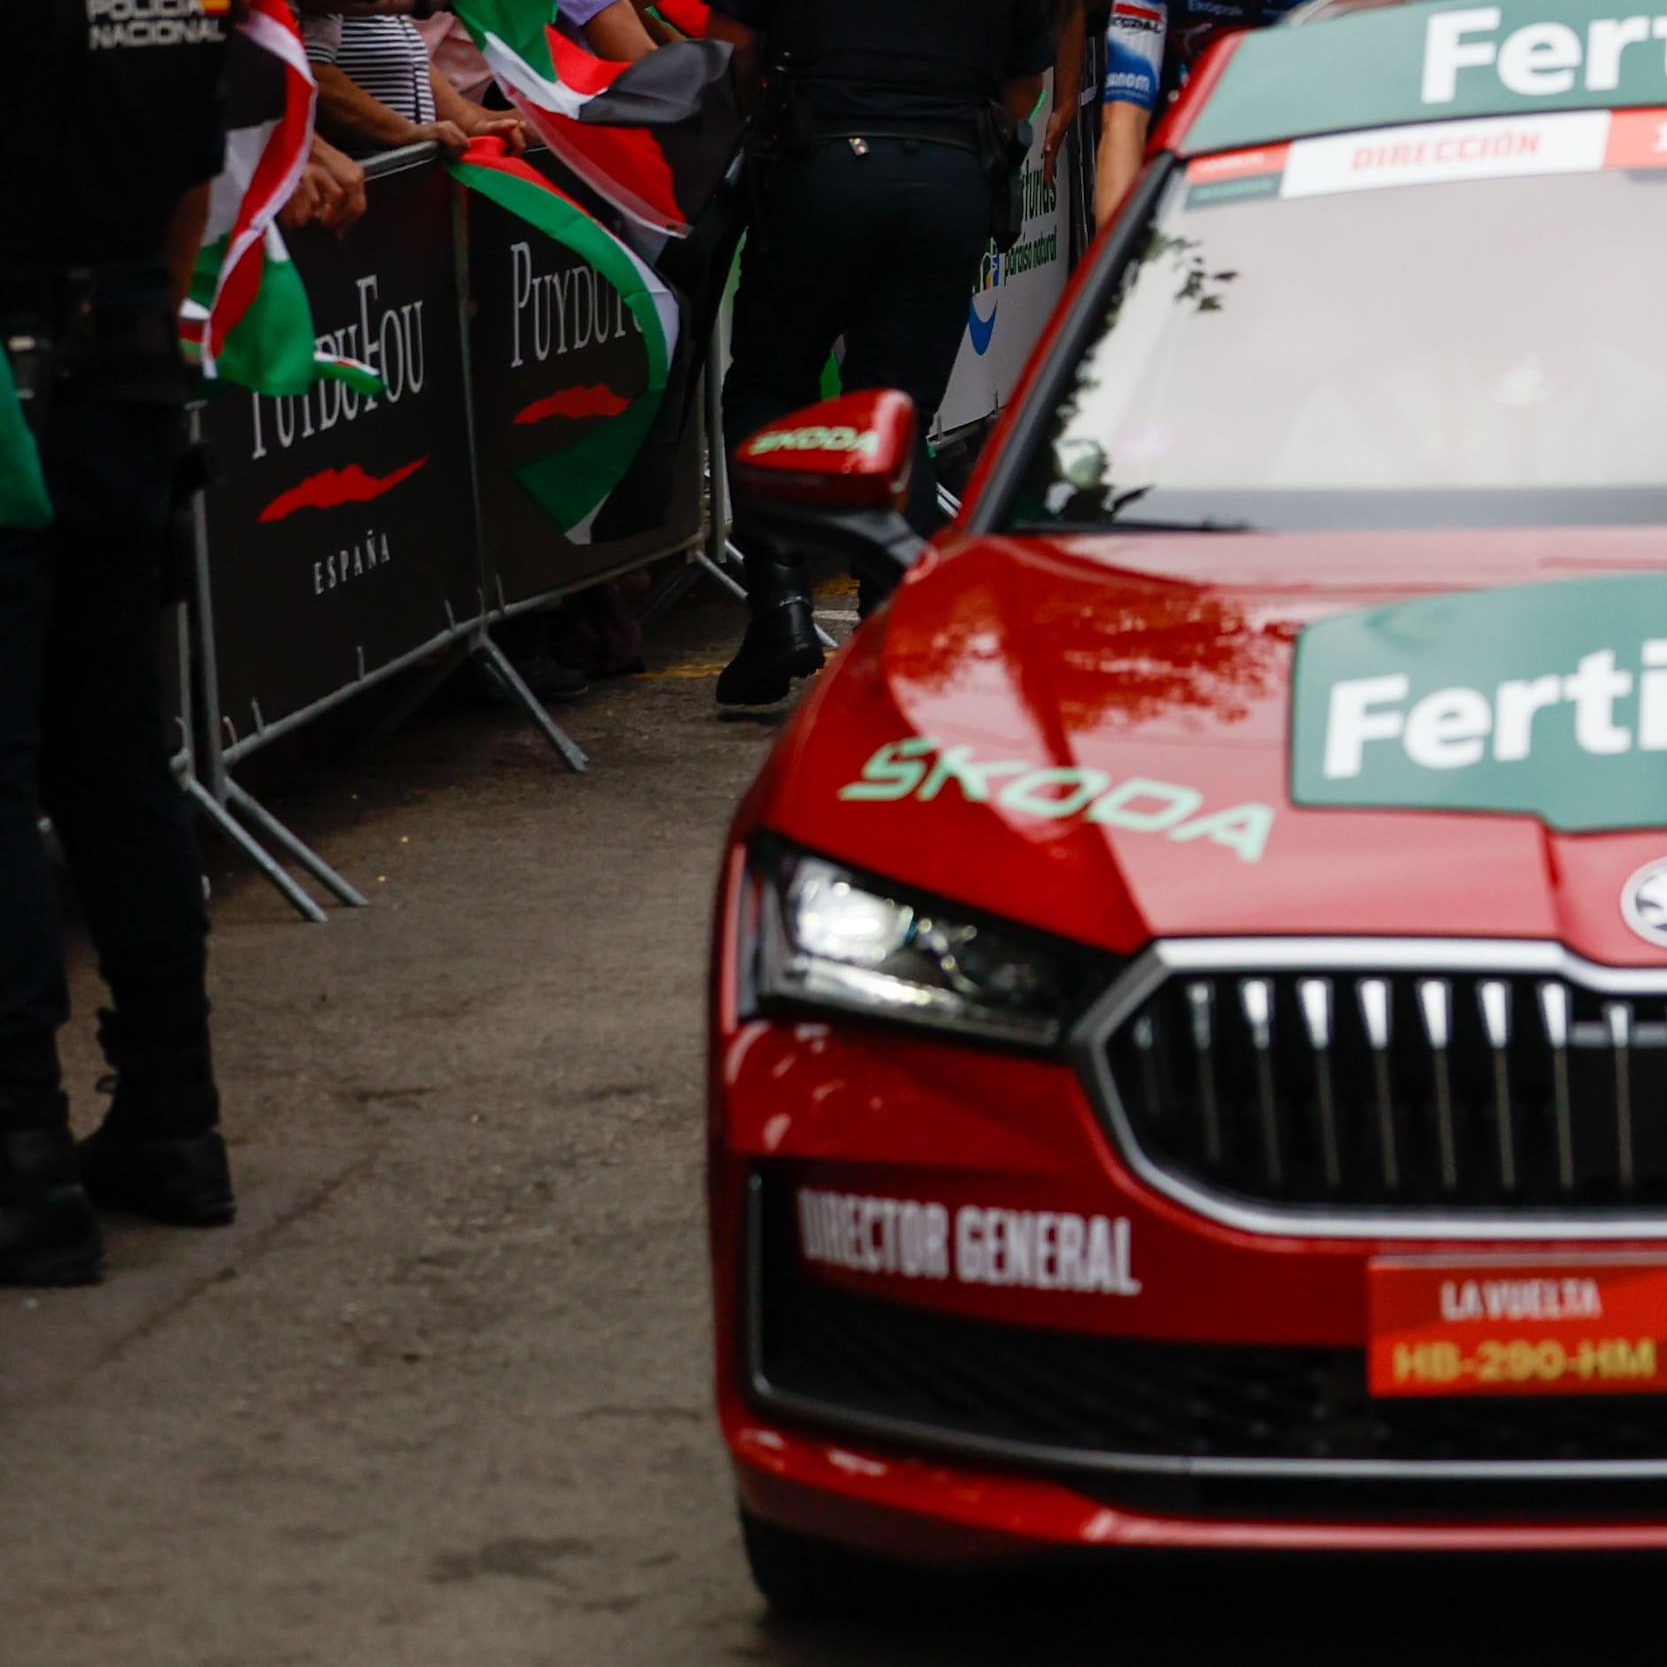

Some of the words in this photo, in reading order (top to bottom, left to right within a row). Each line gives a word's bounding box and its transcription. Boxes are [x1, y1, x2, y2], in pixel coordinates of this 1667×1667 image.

[89, 17, 227, 50] NACIONAL
[1351, 128, 1542, 173] DIRECCIÓN
[313, 528, 391, 595] ESPAÑA
[800, 1188, 947, 1278] DIRECTOR
[956, 1205, 1142, 1296] GENERAL
